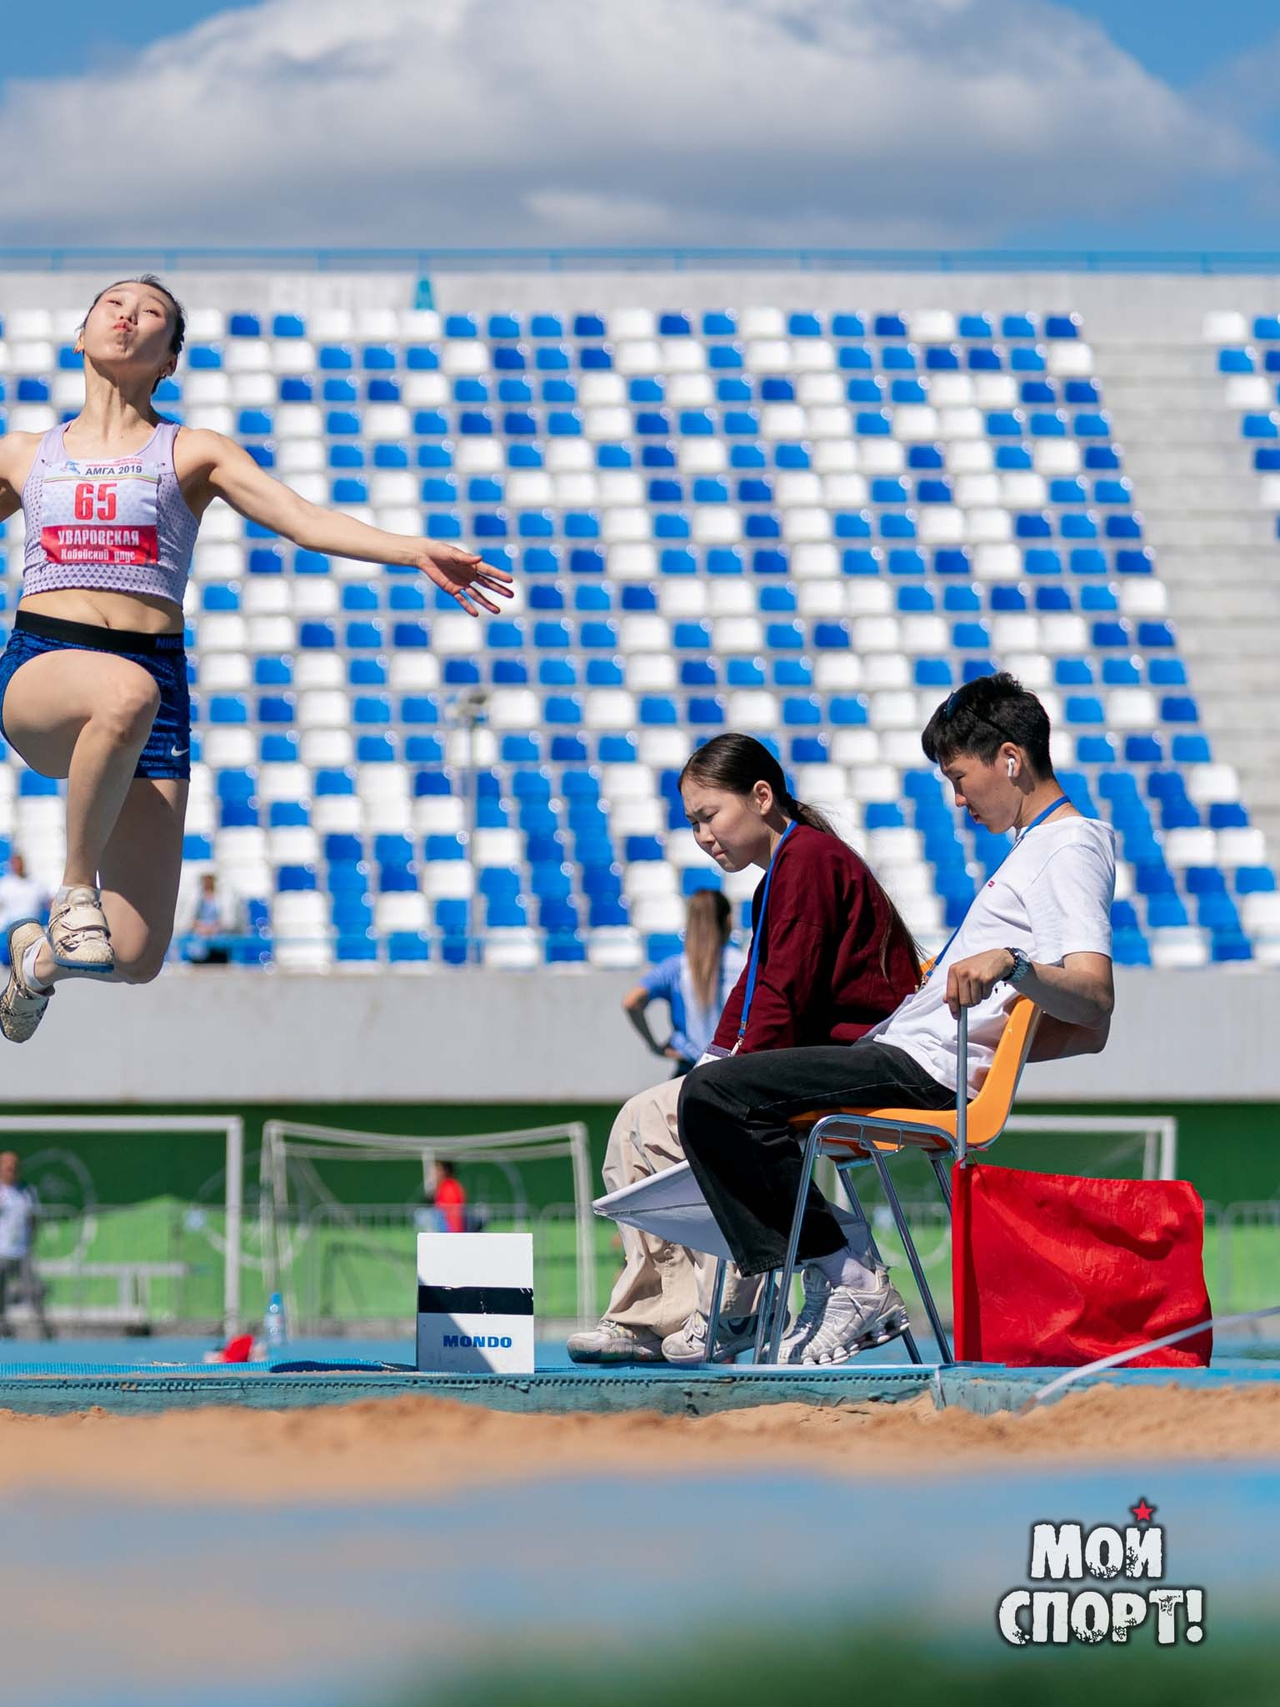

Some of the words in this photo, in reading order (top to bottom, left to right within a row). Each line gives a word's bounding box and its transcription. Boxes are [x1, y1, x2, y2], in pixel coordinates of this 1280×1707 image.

[85, 467, 115, 475] АМГА
[119, 465, 142, 474] 2019
[74, 483, 118, 521] 65
[57, 530, 140, 546] УВАРОВСКАЯ
[155, 637, 182, 649] NIKE
[443, 1335, 512, 1348] MONDO
